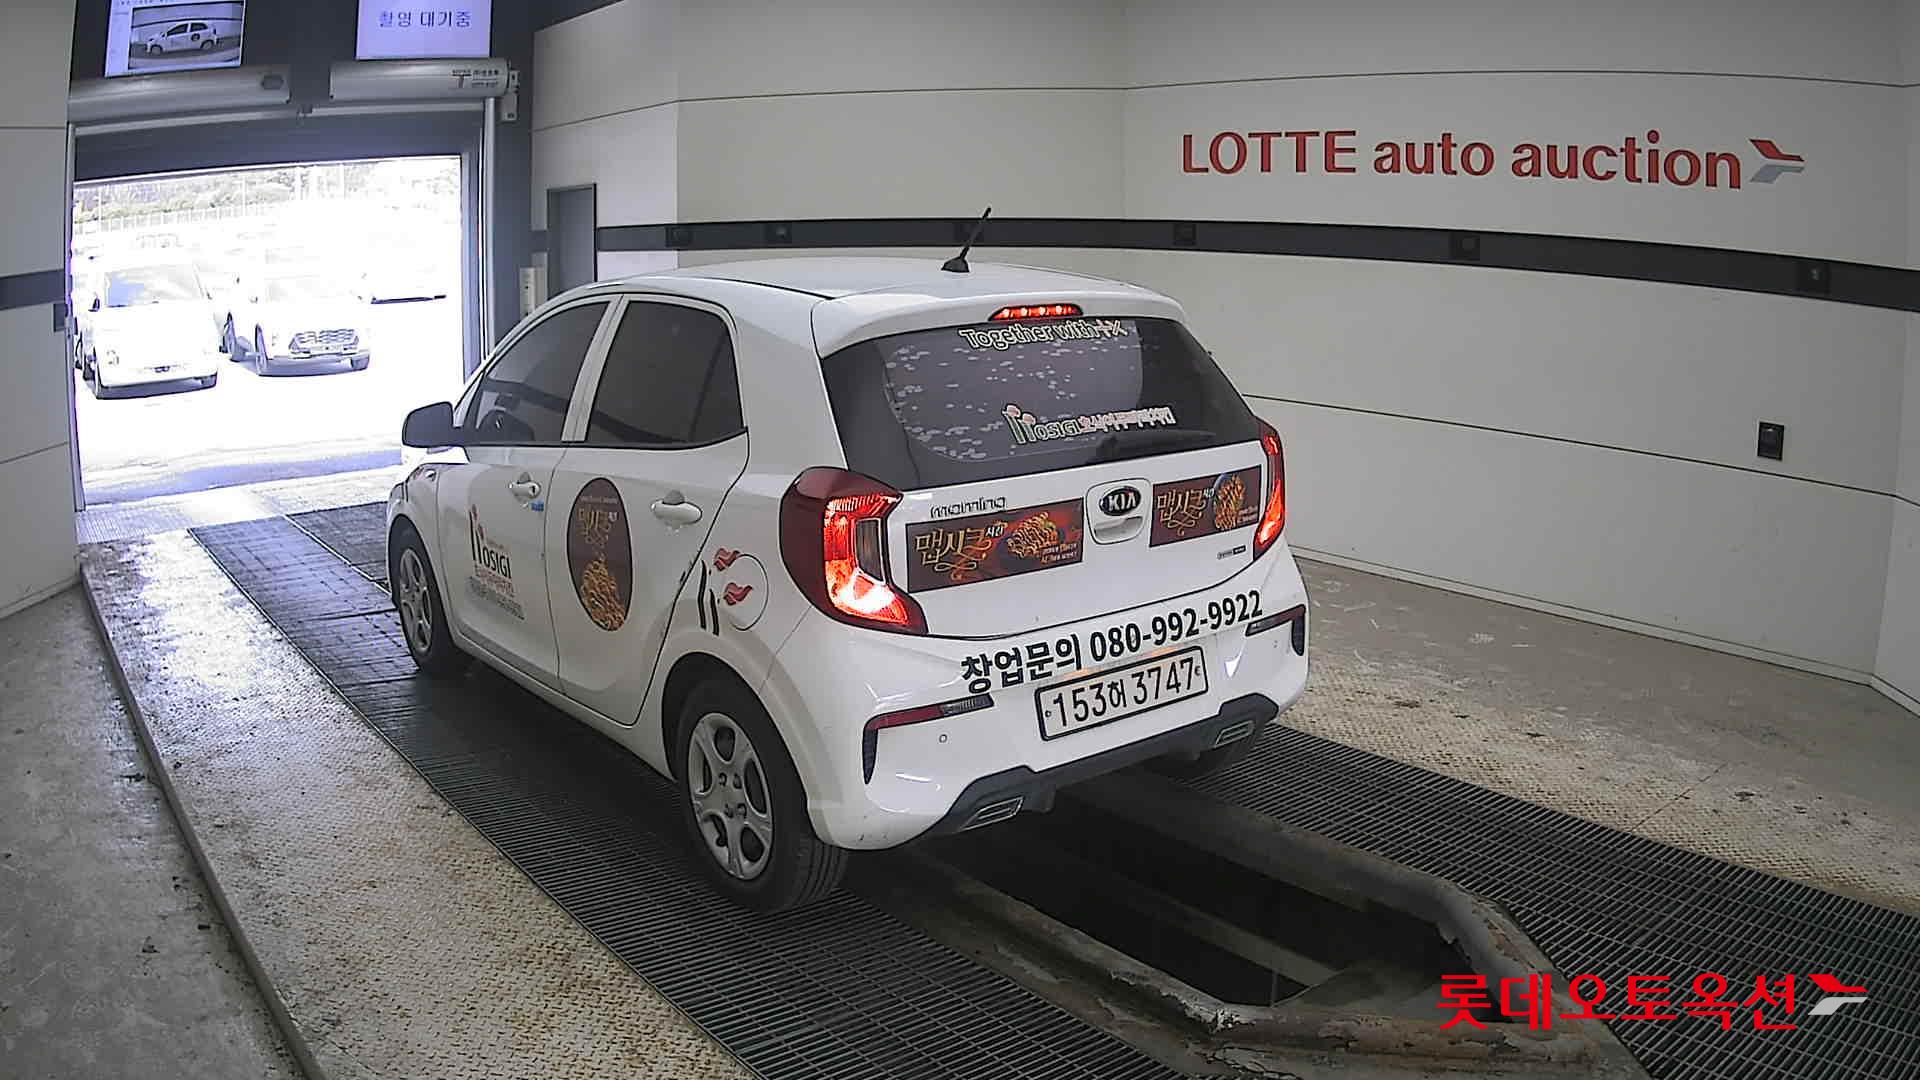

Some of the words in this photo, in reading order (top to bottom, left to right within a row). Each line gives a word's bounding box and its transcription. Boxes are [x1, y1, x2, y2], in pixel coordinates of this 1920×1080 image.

[419, 9, 473, 29] 대기중
[1182, 130, 1357, 175] LOTTE
[1373, 132, 1495, 176] auto
[1511, 131, 1742, 190] auction
[958, 323, 1055, 350] Together
[1105, 489, 1139, 514] KIA
[961, 633, 1083, 694] 창업문의
[1089, 589, 1263, 663] 080-992-9922
[1052, 678, 1128, 727] 153허
[1130, 656, 1195, 705] 3747
